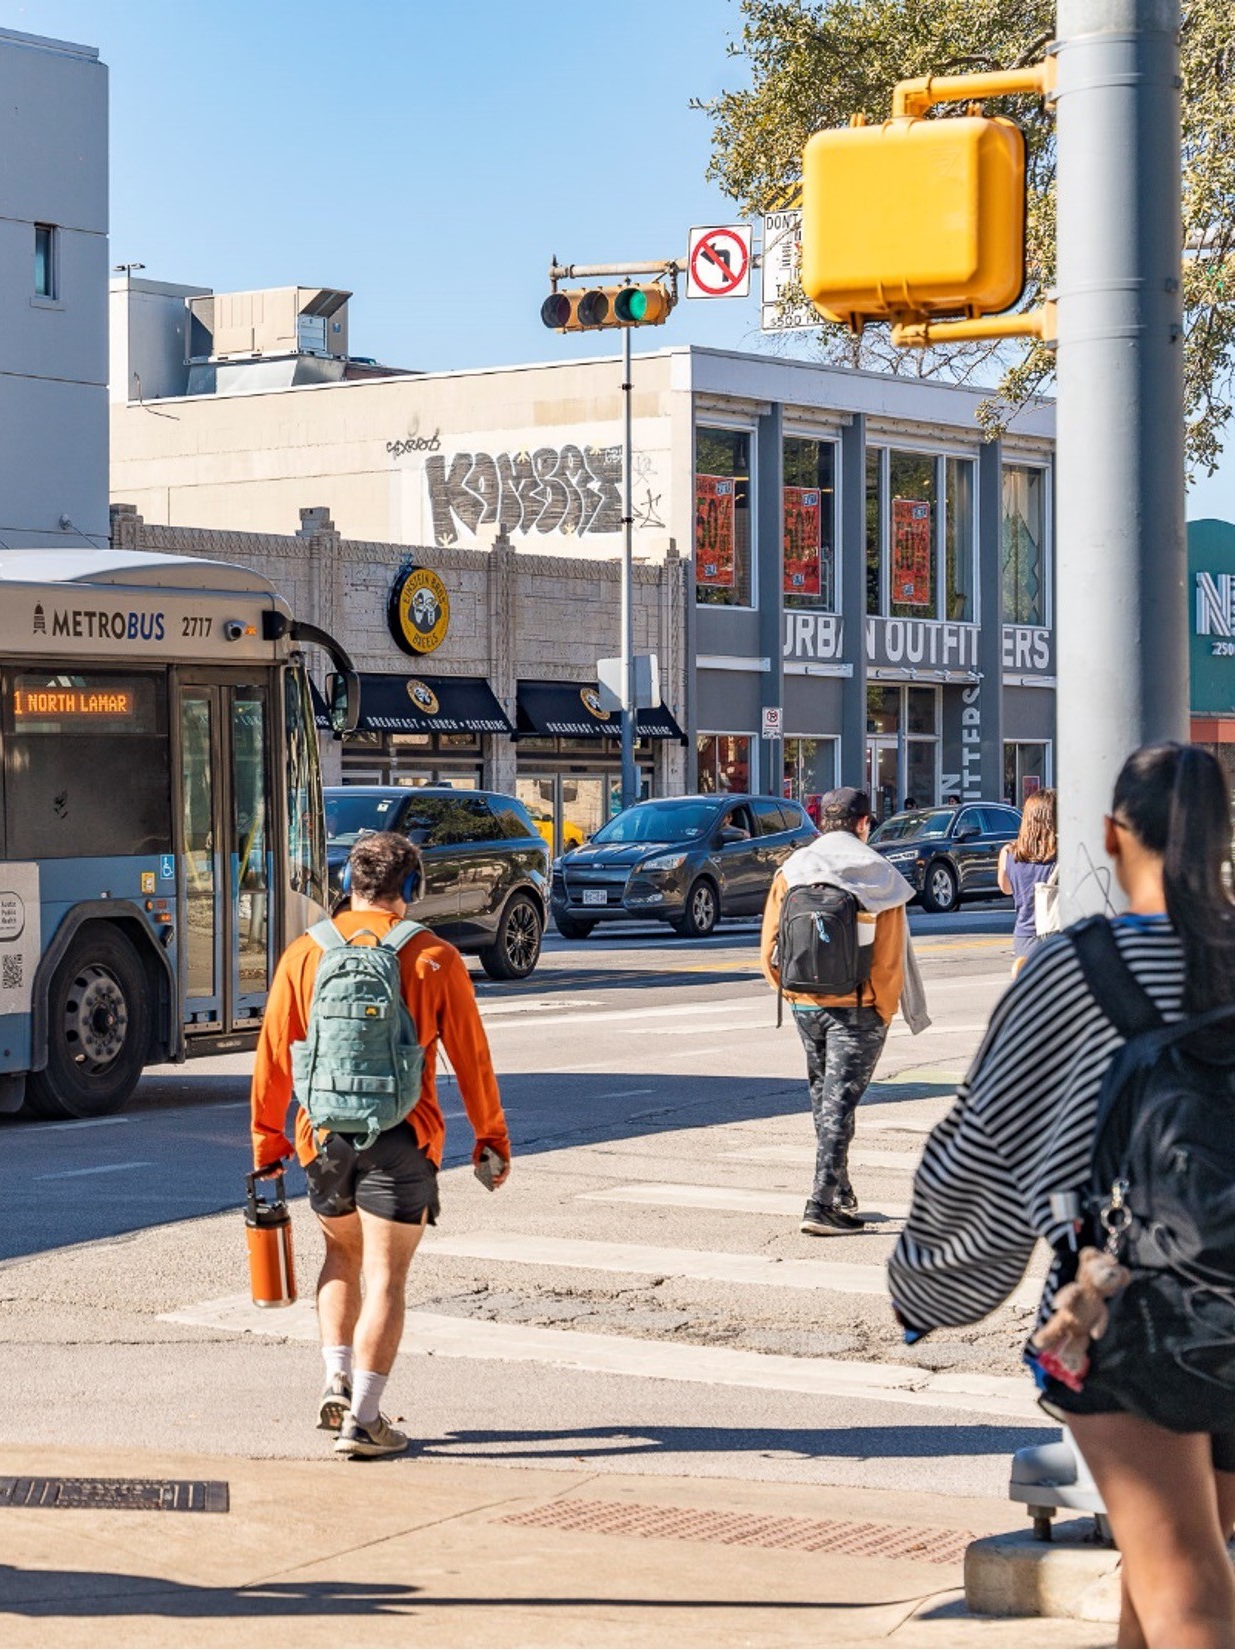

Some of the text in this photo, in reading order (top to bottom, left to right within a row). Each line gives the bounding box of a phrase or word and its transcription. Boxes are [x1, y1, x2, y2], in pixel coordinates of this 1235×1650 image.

[766, 212, 799, 230] DON'T
[52, 609, 165, 640] METROBUS
[181, 617, 212, 638] 2717
[885, 621, 1050, 669] OUTFITERS
[14, 690, 127, 714] 1 NORTH LAMAR
[366, 716, 507, 731] BREAKFAST LUNCH CATERING
[546, 722, 593, 733] BREAKFAST
